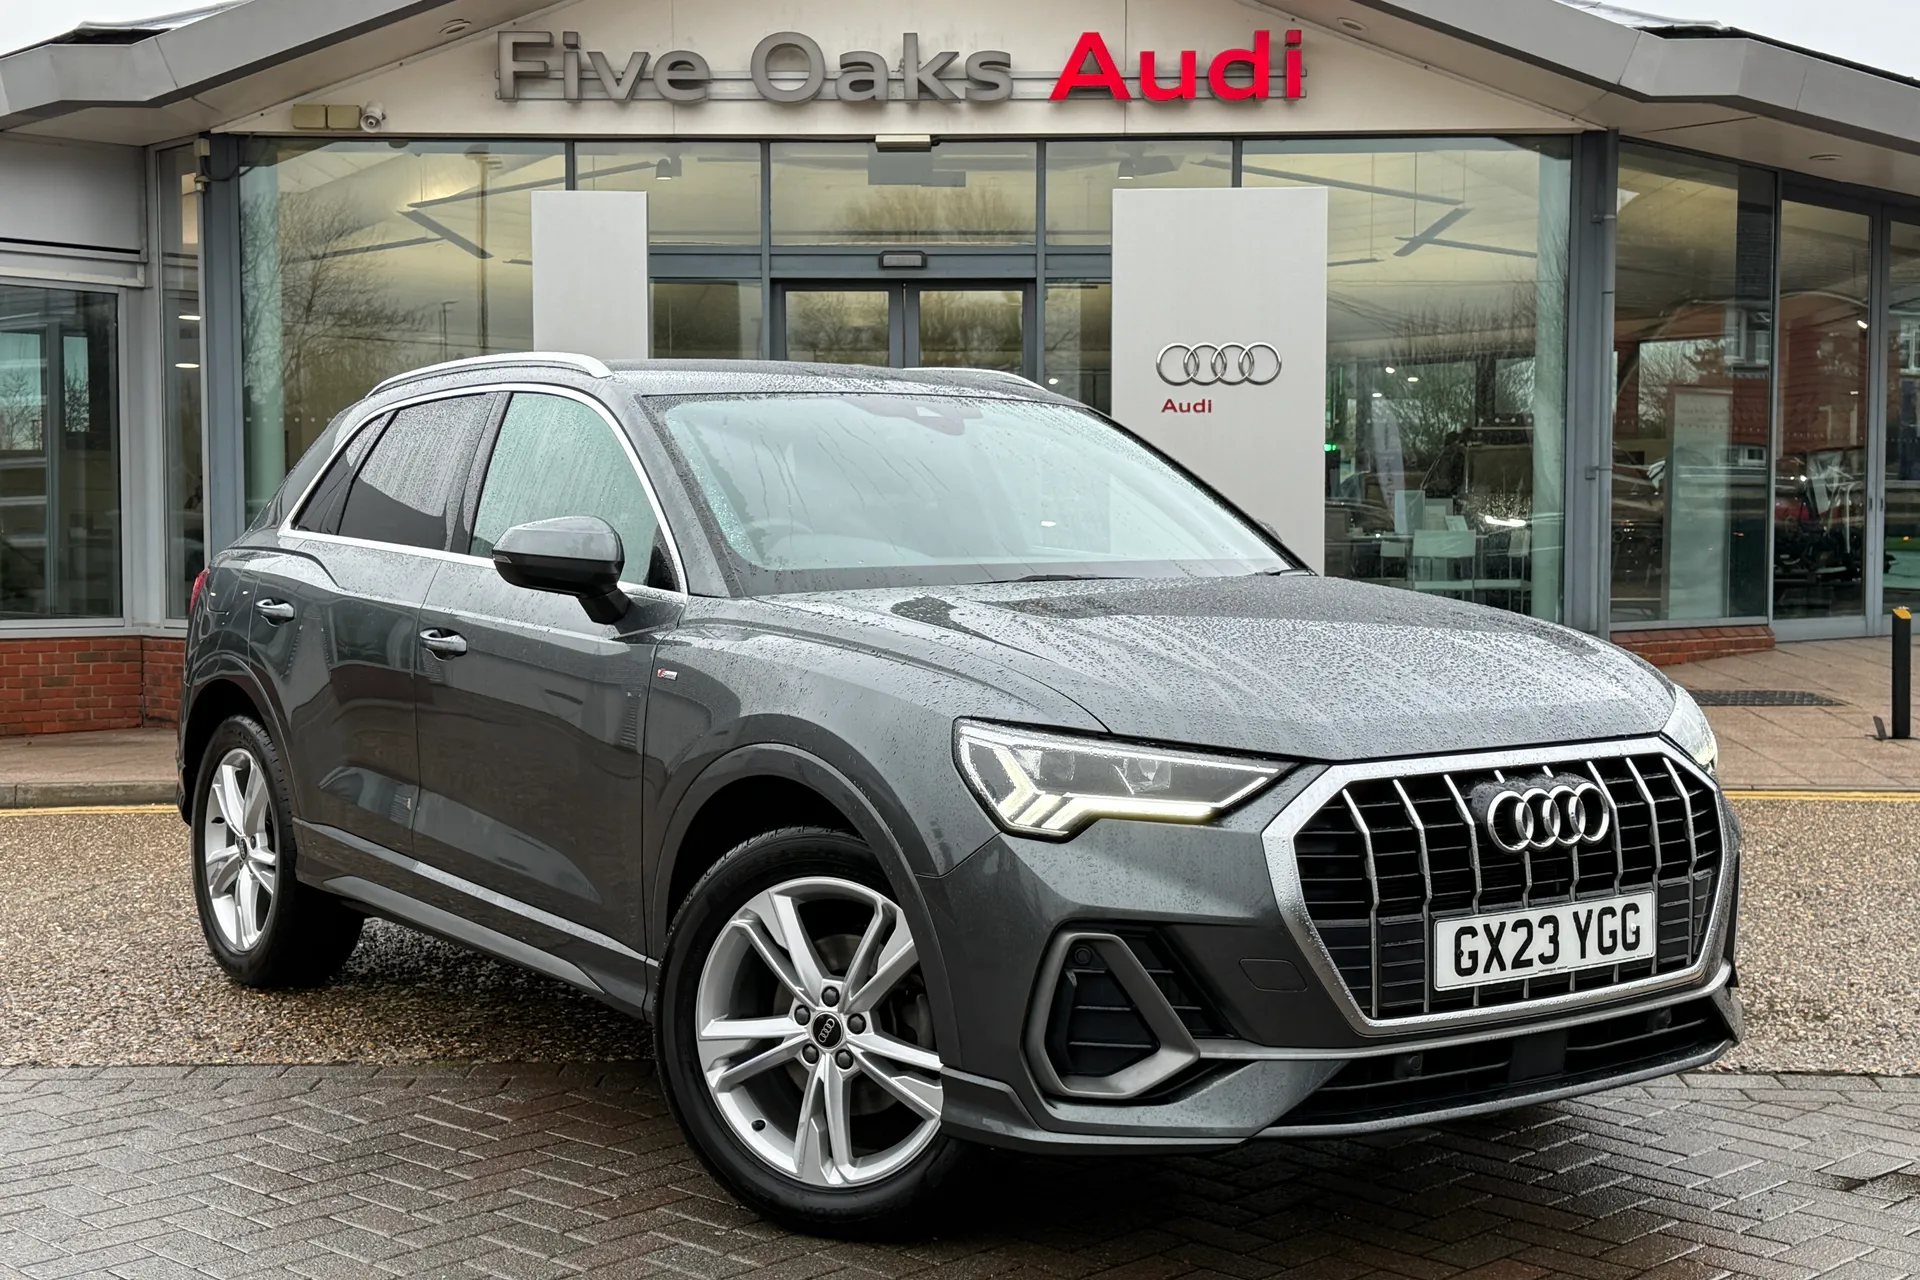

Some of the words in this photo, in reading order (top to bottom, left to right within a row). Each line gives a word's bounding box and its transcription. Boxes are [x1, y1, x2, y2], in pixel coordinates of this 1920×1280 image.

[498, 31, 712, 103] Five
[751, 31, 1014, 103] Oaks
[1049, 30, 1302, 102] Audi
[1161, 398, 1212, 413] Audi
[1454, 914, 1560, 977] GX23
[1572, 902, 1641, 960] YGG
